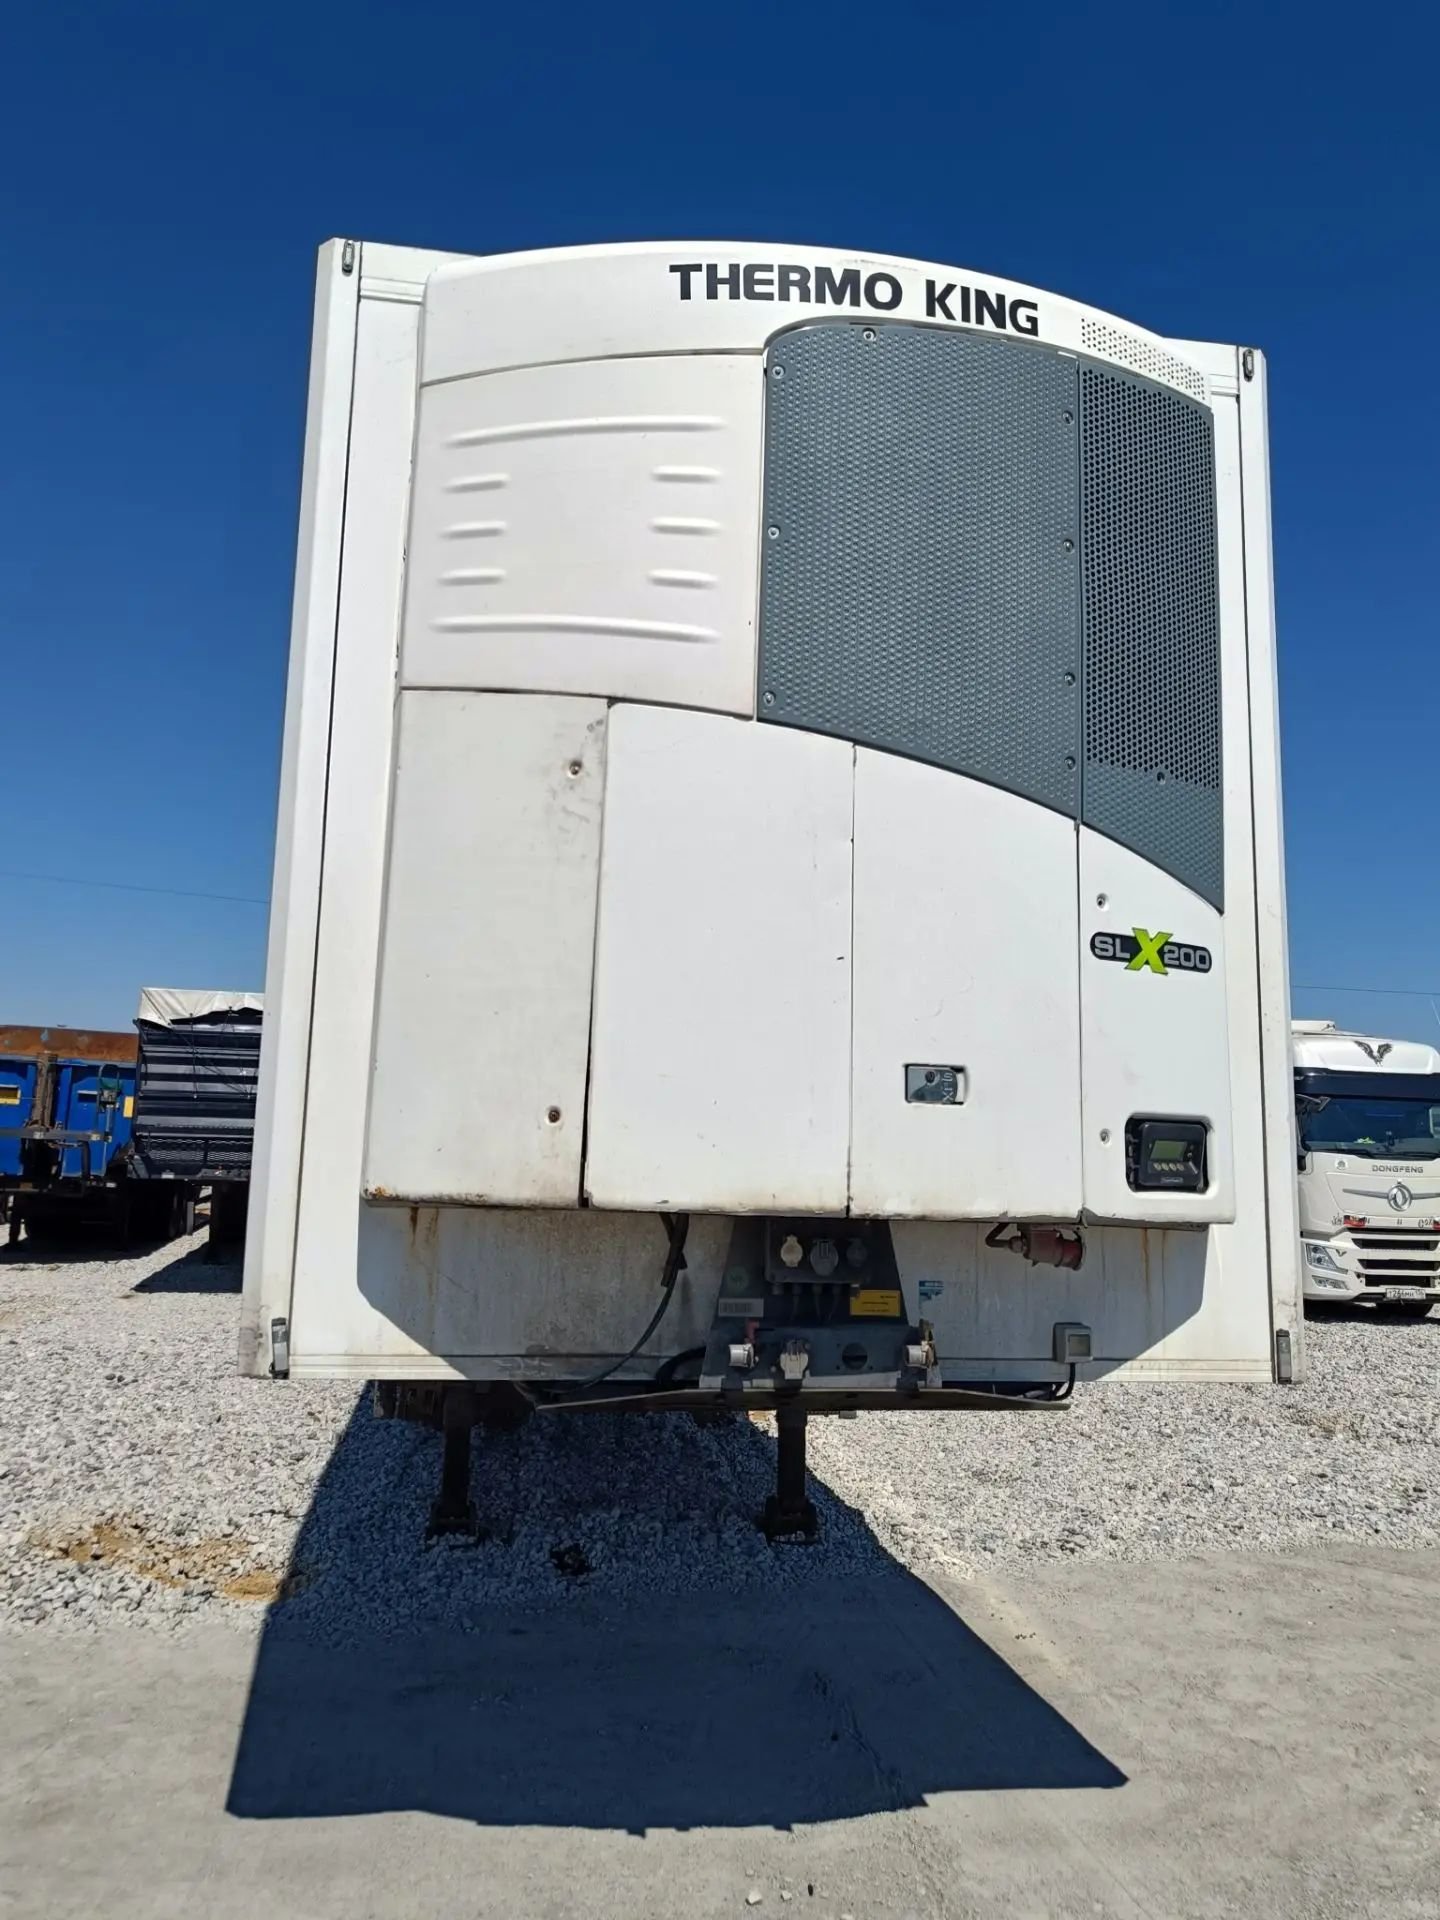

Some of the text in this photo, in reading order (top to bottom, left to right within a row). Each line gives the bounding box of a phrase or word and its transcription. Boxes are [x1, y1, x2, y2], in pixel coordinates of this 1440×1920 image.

[669, 263, 1039, 337] THERMO KING
[1371, 1164, 1424, 1174] DONGFENG
